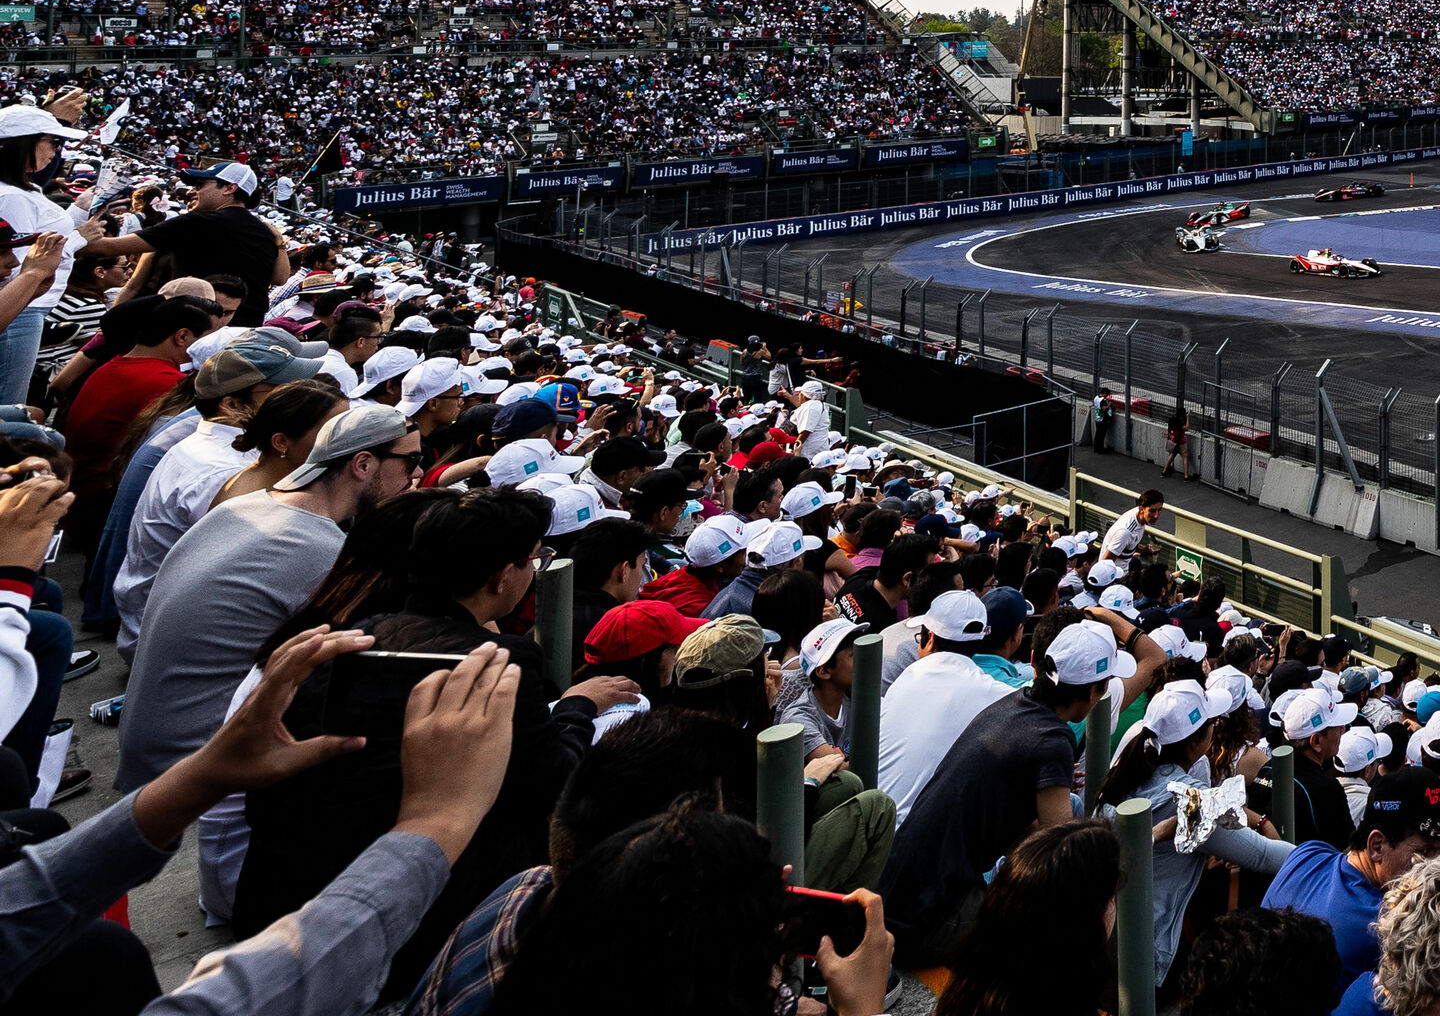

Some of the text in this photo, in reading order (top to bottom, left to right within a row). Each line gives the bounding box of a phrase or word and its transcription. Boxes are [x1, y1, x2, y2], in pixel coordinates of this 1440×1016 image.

[783, 158, 806, 168] Julius
[809, 156, 824, 164] Bär
[878, 148, 928, 161] Julius Bär
[1362, 154, 1388, 166] Julius Bär
[650, 166, 687, 180] Julius
[692, 164, 714, 175] Bär
[1255, 164, 1289, 178] Julius Bär
[1293, 161, 1326, 174] Julius Bär
[1329, 158, 1359, 170] Julius Bär
[529, 178, 560, 190] Julius
[1168, 174, 1210, 190] Julius Bär
[1214, 169, 1250, 184] Julius Bär
[1065, 188, 1112, 204] Julius Bär
[1118, 181, 1162, 196] Julius Bär
[355, 188, 440, 207] Julius Bär
[1008, 194, 1060, 210] Julius Bär
[880, 208, 940, 226] Julius Bär
[947, 201, 1002, 218] Julius Bär
[733, 224, 802, 242] Julius Bär
[810, 216, 874, 234] Julius Bär
[840, 596, 858, 623] SENNA
[846, 593, 864, 618] AYRTON
